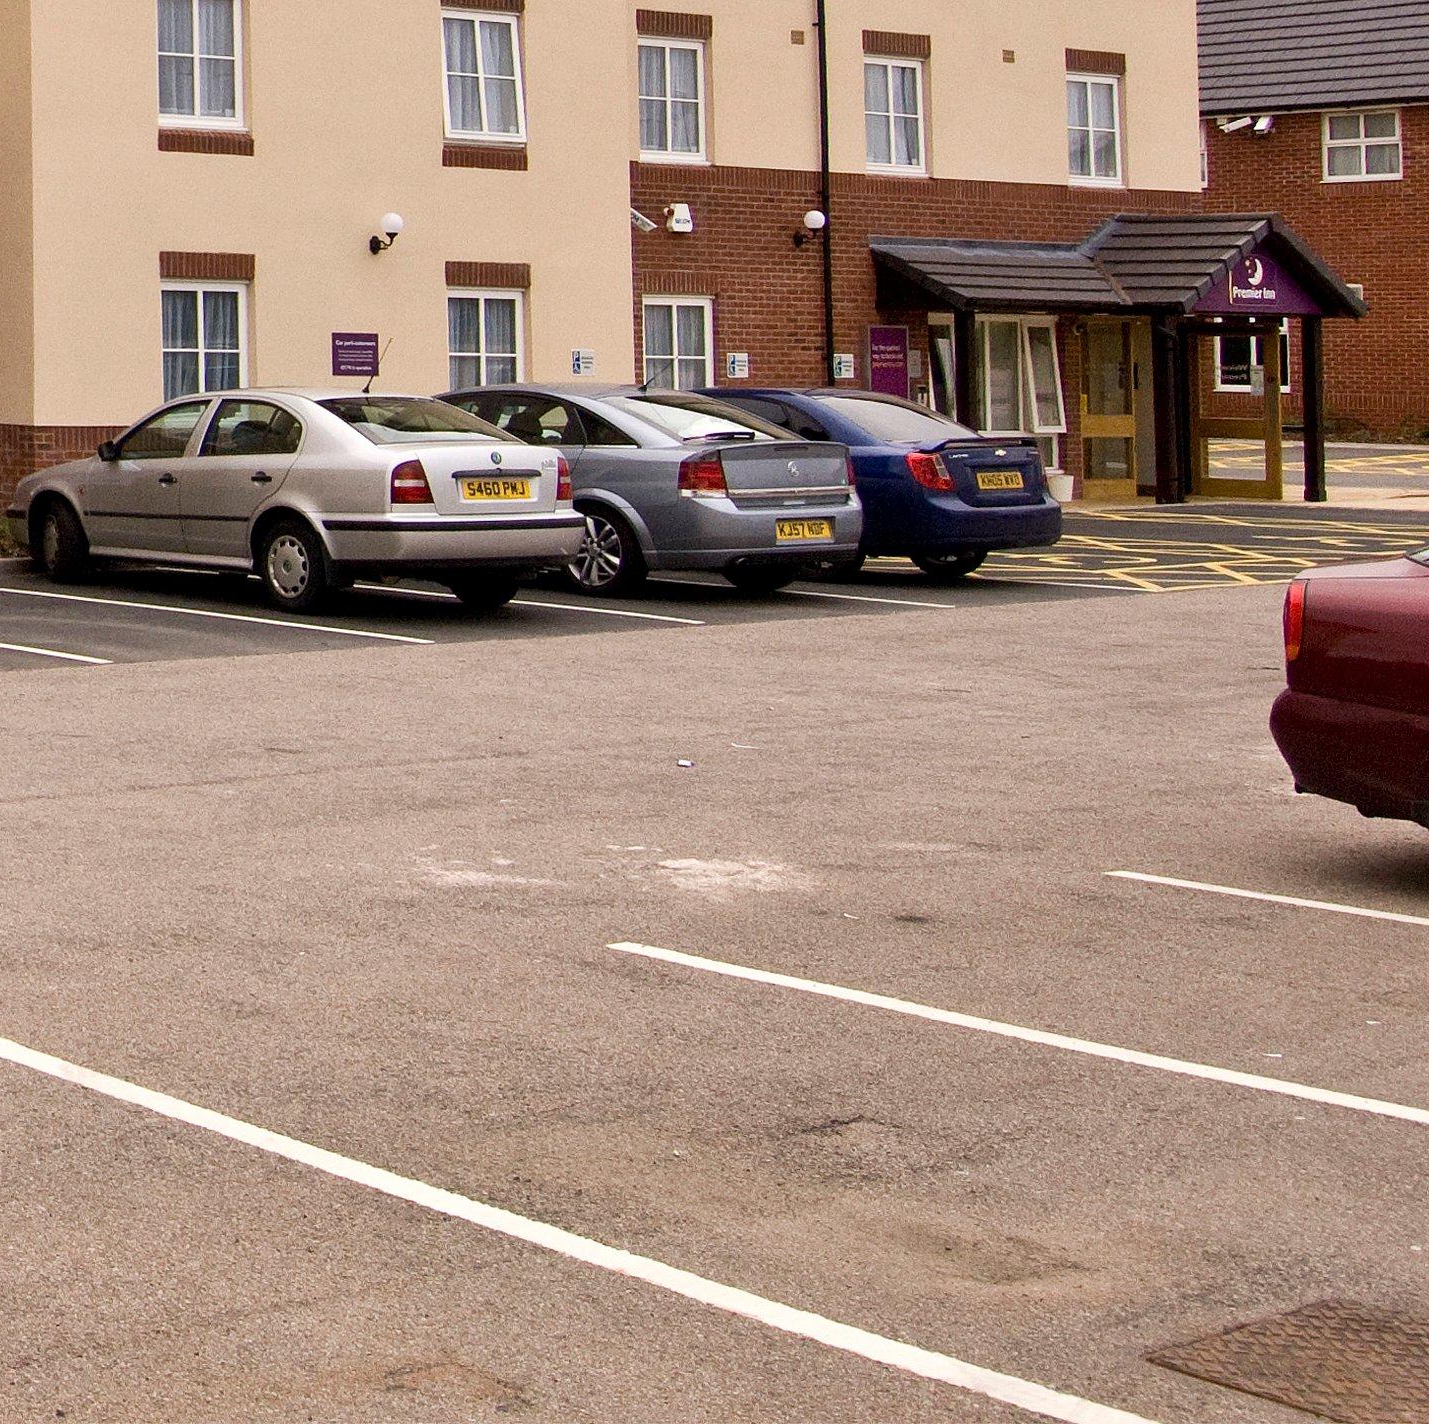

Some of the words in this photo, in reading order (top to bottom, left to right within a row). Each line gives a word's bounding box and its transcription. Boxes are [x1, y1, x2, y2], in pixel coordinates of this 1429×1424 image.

[467, 481, 501, 496] S460
[502, 481, 526, 496] PMJ
[778, 522, 805, 537] KJ57
